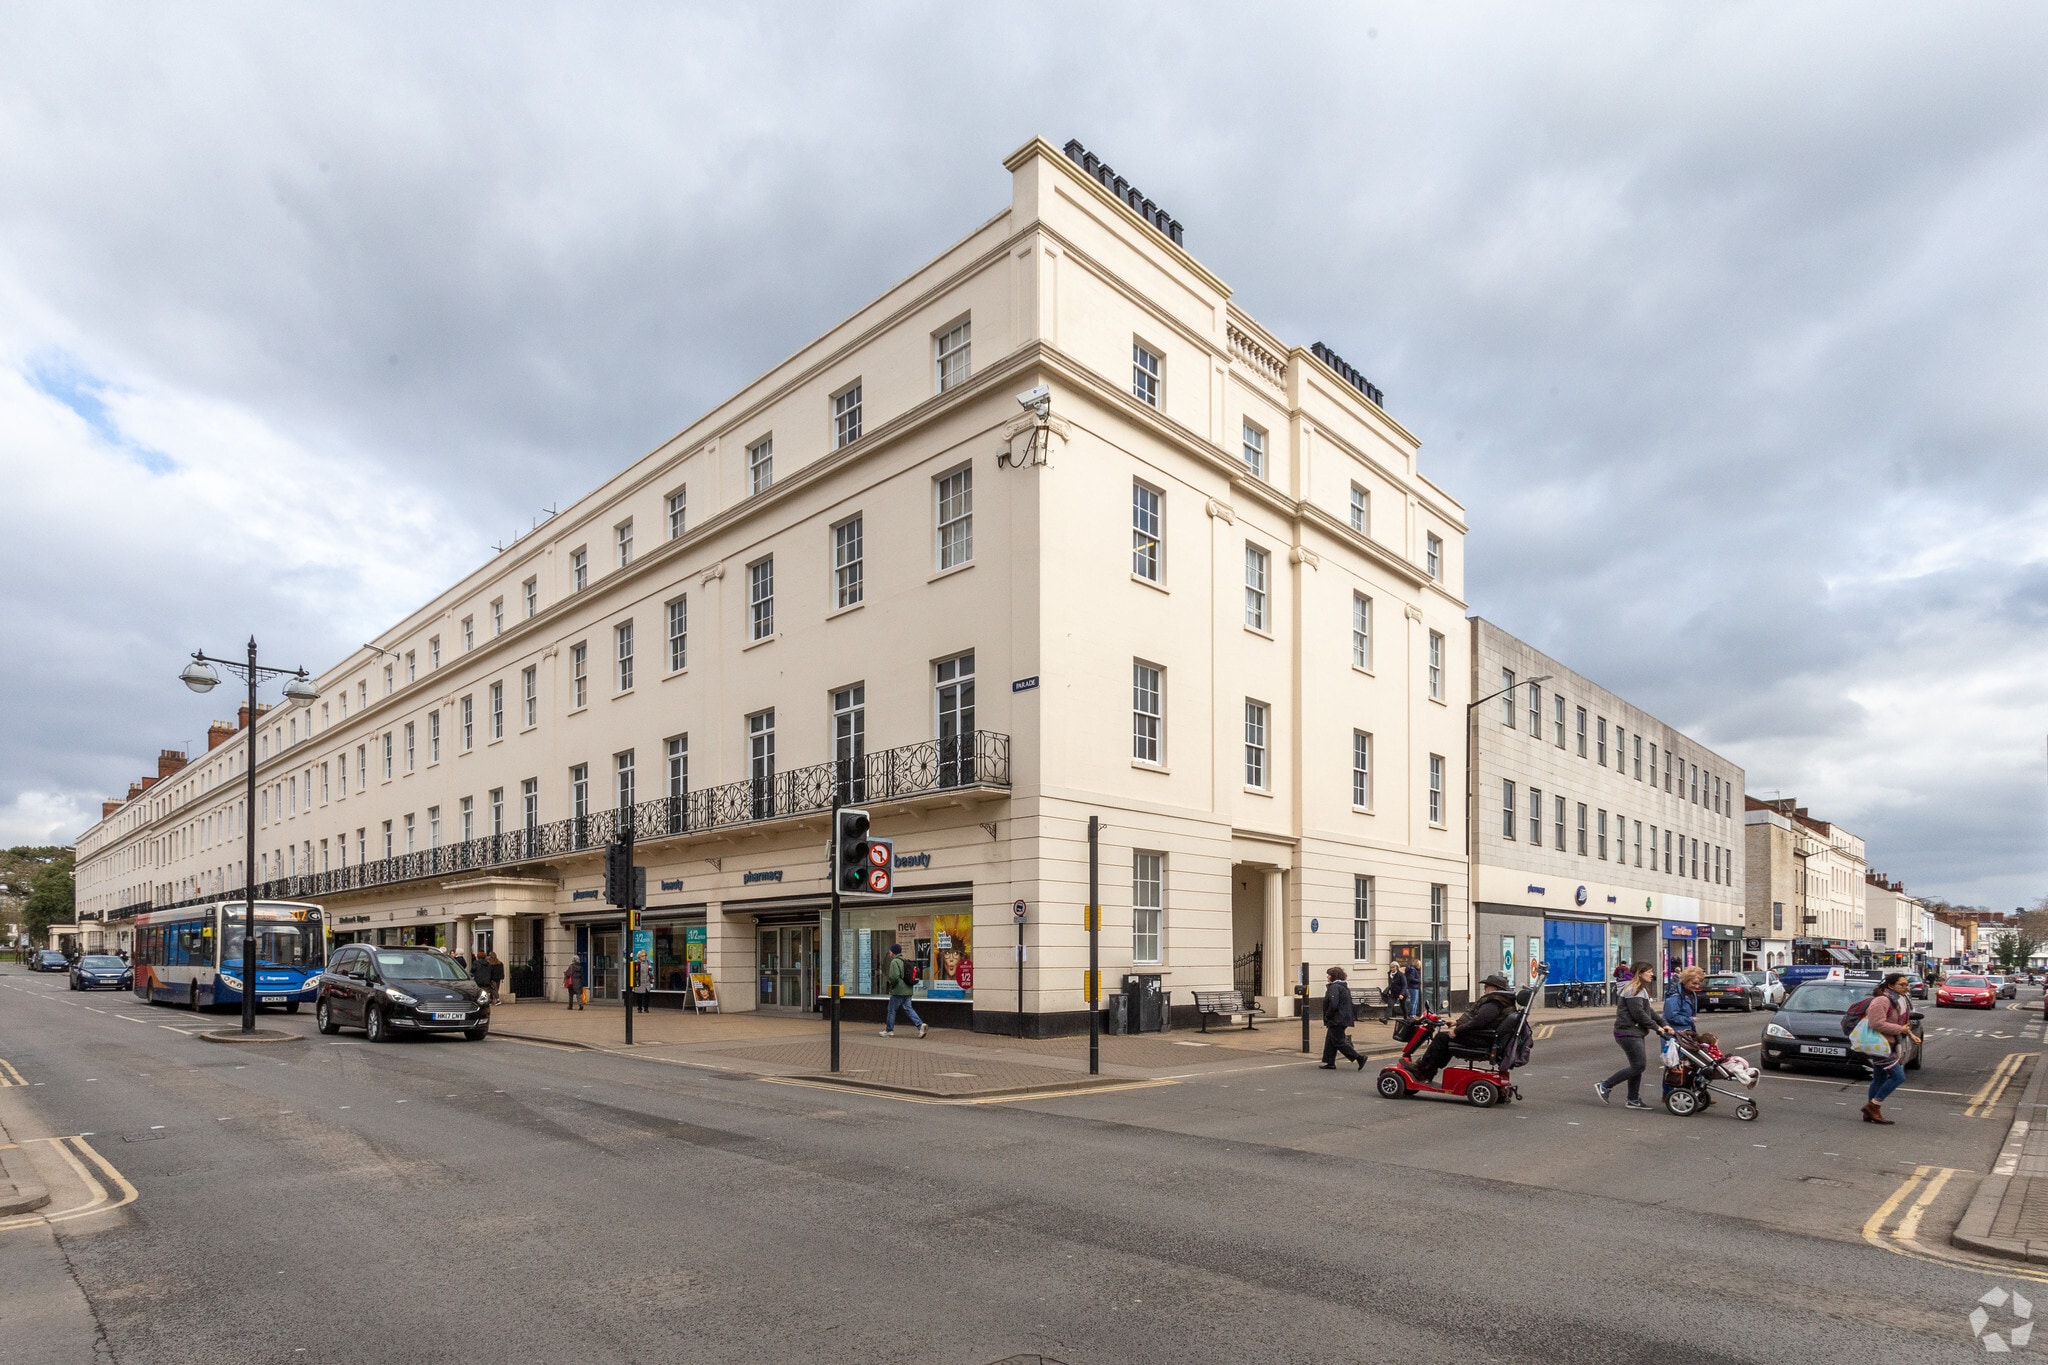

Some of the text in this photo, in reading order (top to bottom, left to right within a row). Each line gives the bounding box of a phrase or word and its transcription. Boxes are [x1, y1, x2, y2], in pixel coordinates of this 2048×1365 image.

[894, 852, 931, 868] beauty
[743, 869, 783, 885] pharmacy
[661, 879, 683, 891] beauty
[573, 889, 599, 901] pharmacy
[898, 922, 917, 932] new
[961, 973, 971, 982] 1/2
[1808, 1046, 1824, 1054] WDU
